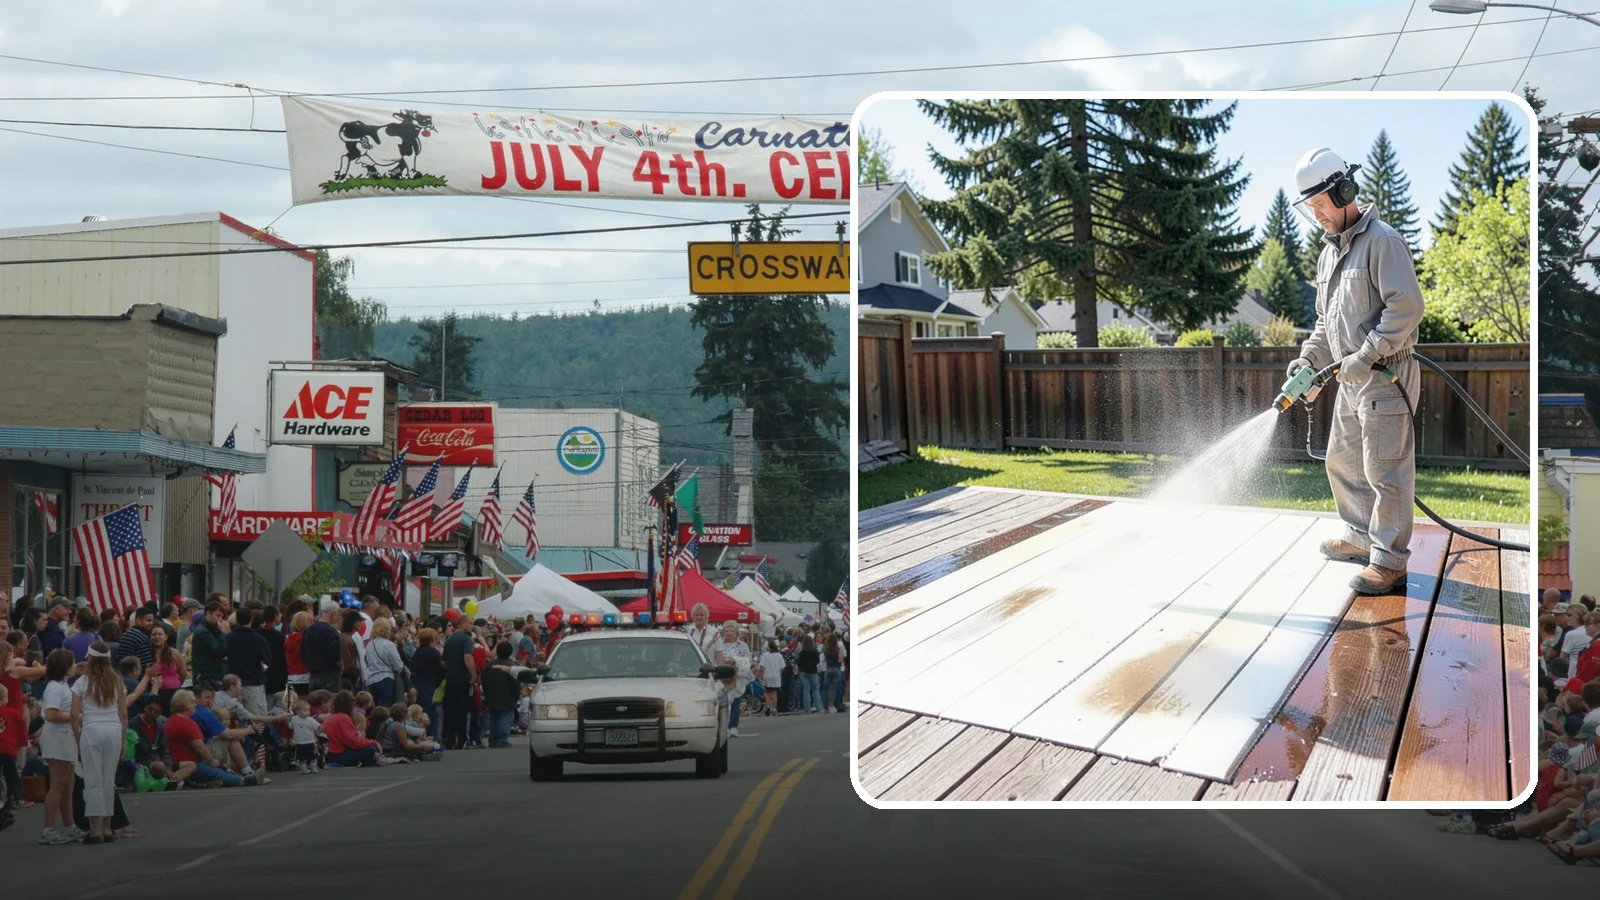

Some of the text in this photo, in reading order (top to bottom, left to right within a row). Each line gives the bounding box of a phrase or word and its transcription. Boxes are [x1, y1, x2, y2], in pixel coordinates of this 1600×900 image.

[695, 121, 850, 150] Carnat
[481, 141, 605, 192] JULY
[632, 150, 746, 198] 4th.
[697, 254, 850, 281] CROSSWA
[282, 380, 374, 420] ACE
[406, 409, 485, 421] CEDAR LOG
[283, 421, 370, 437] Hardware
[416, 428, 477, 447] Coca-Cola
[95, 485, 124, 495] Vincent
[126, 486, 136, 495] de
[137, 486, 155, 496] Paul
[212, 516, 330, 536] HARDARE
[688, 526, 741, 535] CRNATION
[698, 535, 731, 543] GLASS
